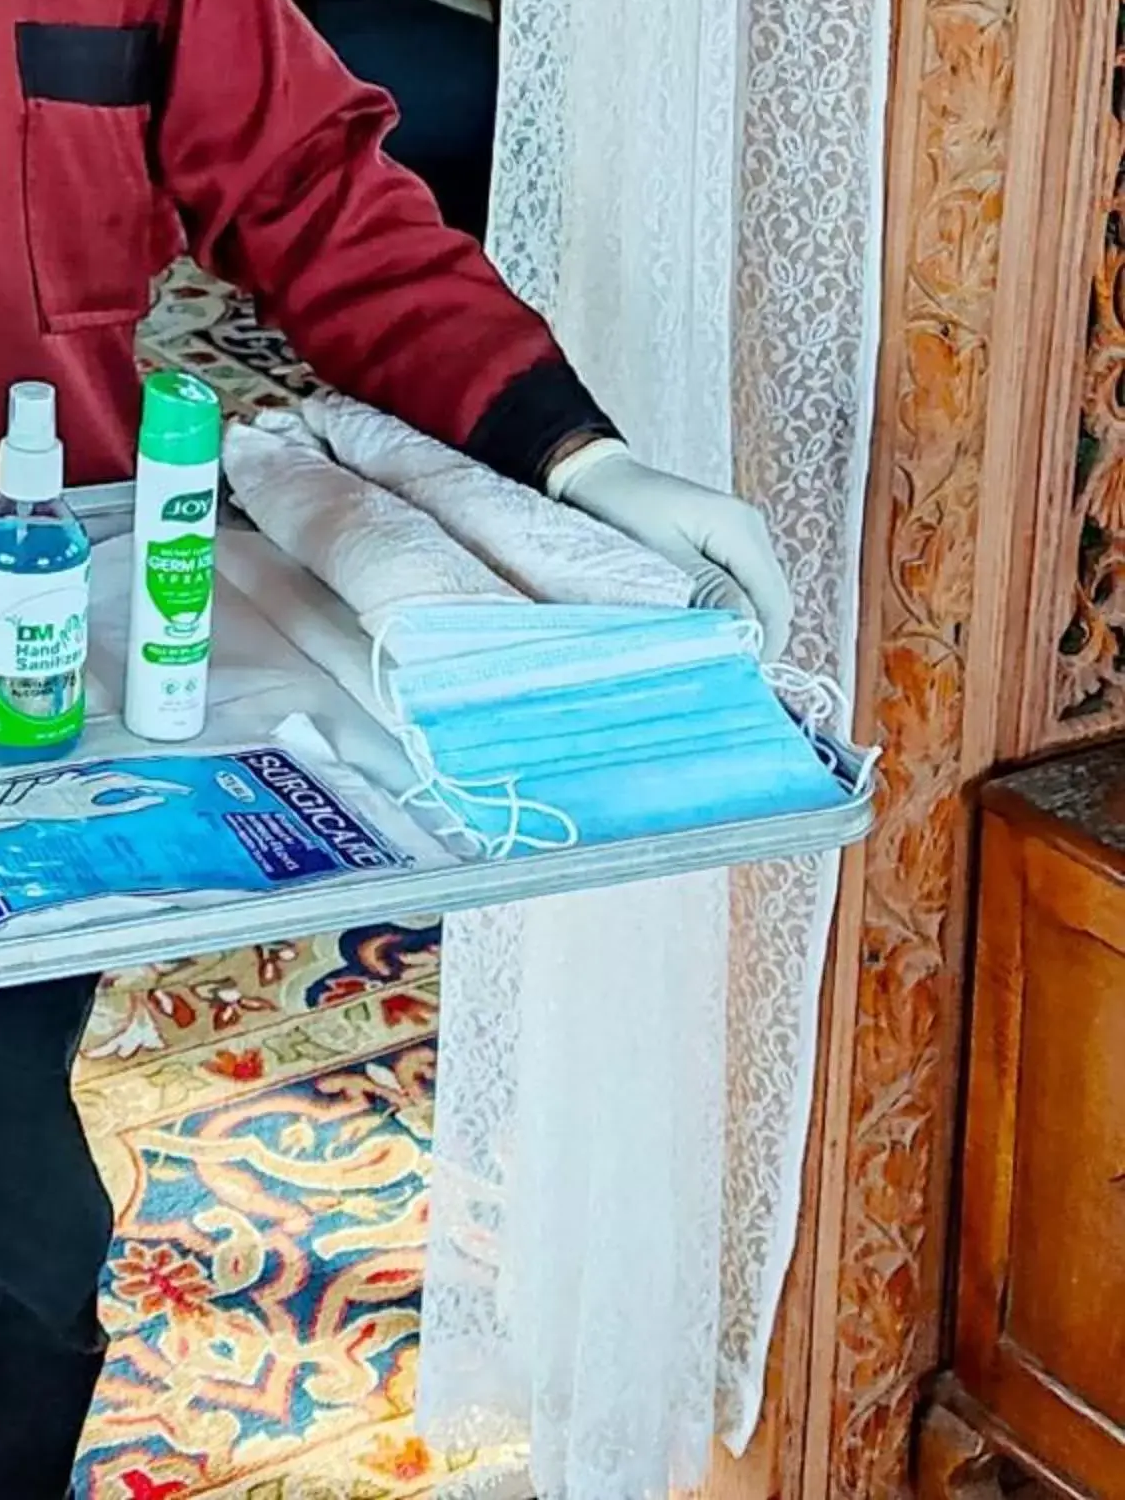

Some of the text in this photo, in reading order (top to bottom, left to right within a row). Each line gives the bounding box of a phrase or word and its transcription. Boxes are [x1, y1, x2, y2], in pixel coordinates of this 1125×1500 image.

[166, 499, 209, 515] JOY
[16, 642, 60, 657] Hand
[248, 755, 387, 870] SURGICARE
